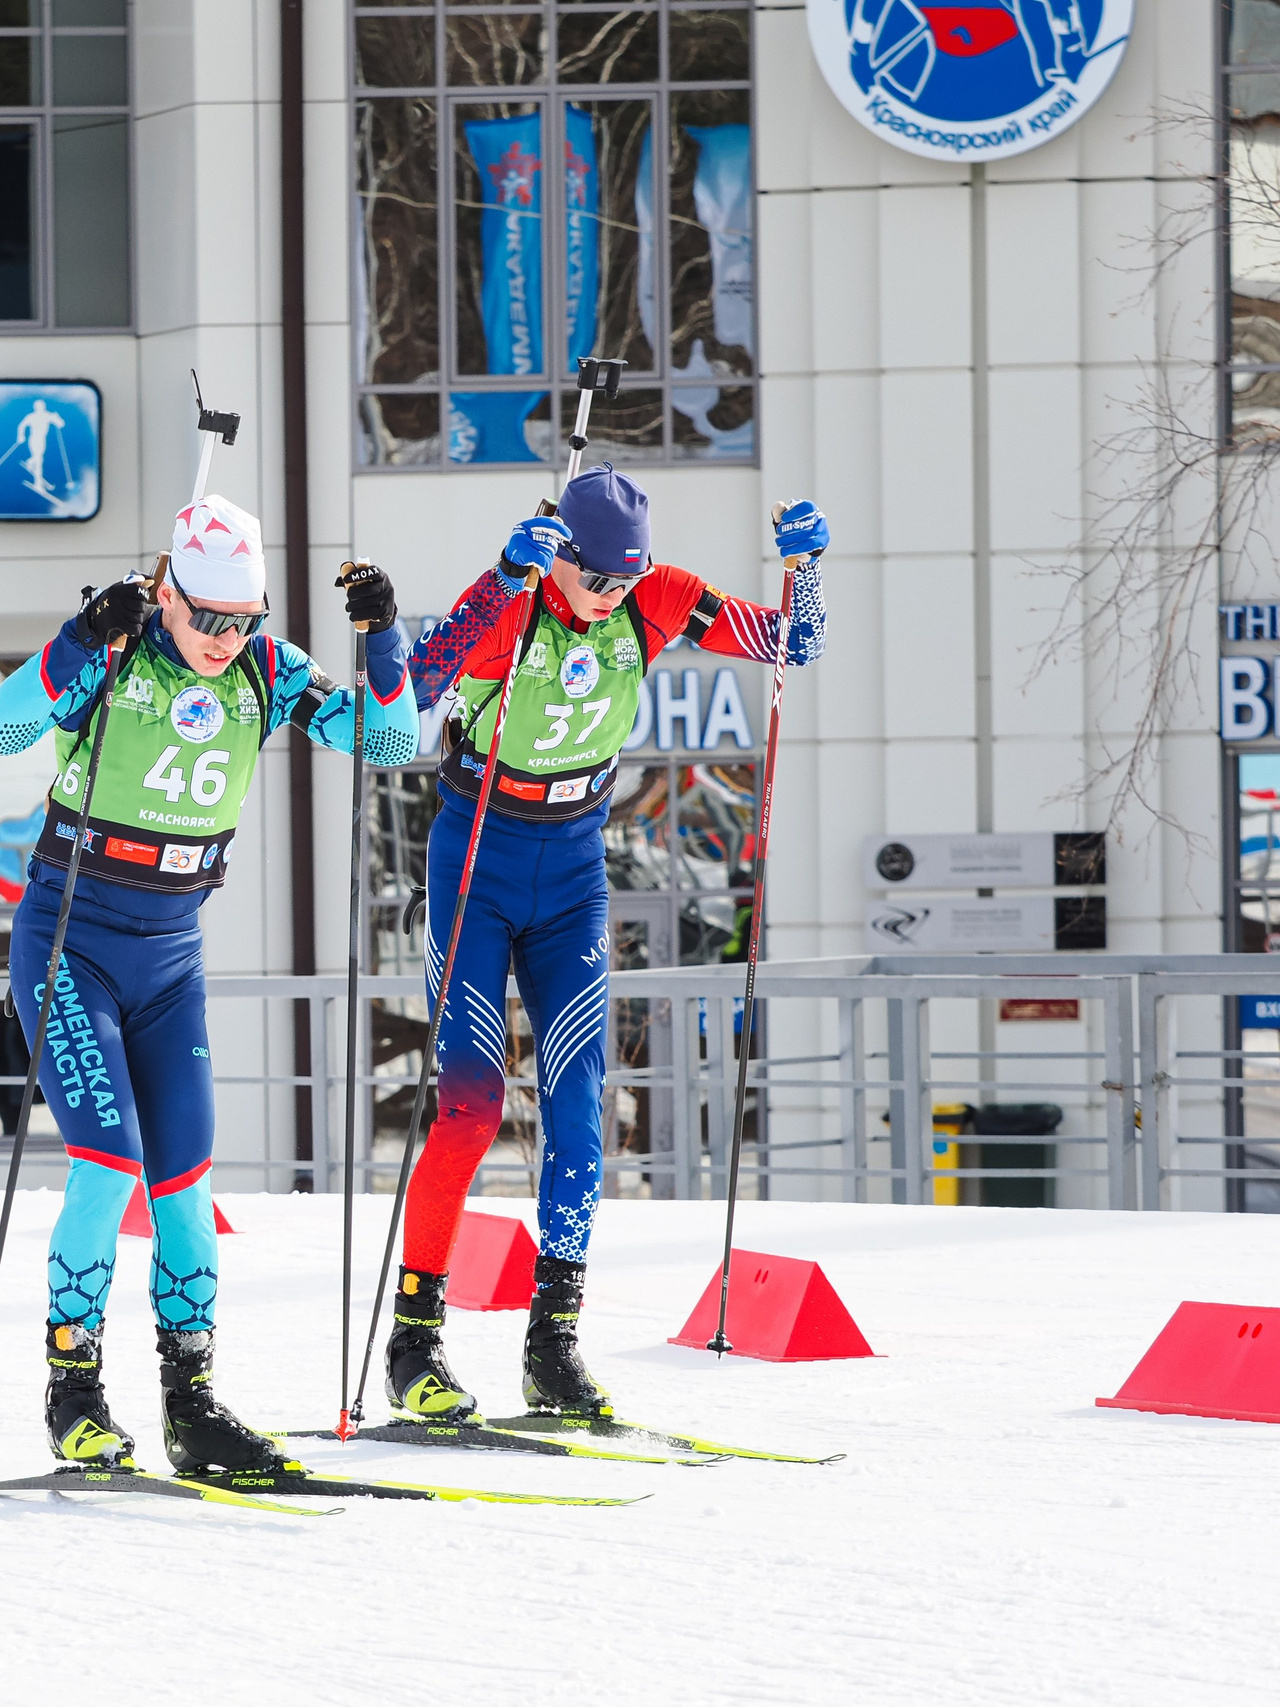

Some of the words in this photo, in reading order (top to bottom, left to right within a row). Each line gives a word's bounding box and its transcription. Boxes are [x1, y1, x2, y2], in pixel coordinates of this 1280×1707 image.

[864, 94, 1025, 154] Красноярский
[1027, 87, 1079, 132] край
[351, 567, 380, 581] MOAX
[532, 695, 612, 751] 37
[528, 748, 598, 768] КРАСНОЯРСК
[142, 745, 231, 807] 46
[139, 808, 217, 828] КРАСНОЯРСК
[476, 813, 485, 836] TRIAC
[33, 983, 86, 1109] ОБЛАСТЬ
[47, 952, 121, 1128] ТЮМЕНСКАЯ
[393, 1313, 442, 1327] FISCHER
[48, 1357, 98, 1369] FISCHER
[427, 1428, 458, 1436] FISCHER
[561, 1419, 591, 1428] FISCHER
[85, 1473, 111, 1481] FISCHER
[232, 1478, 275, 1486] FISCHER
